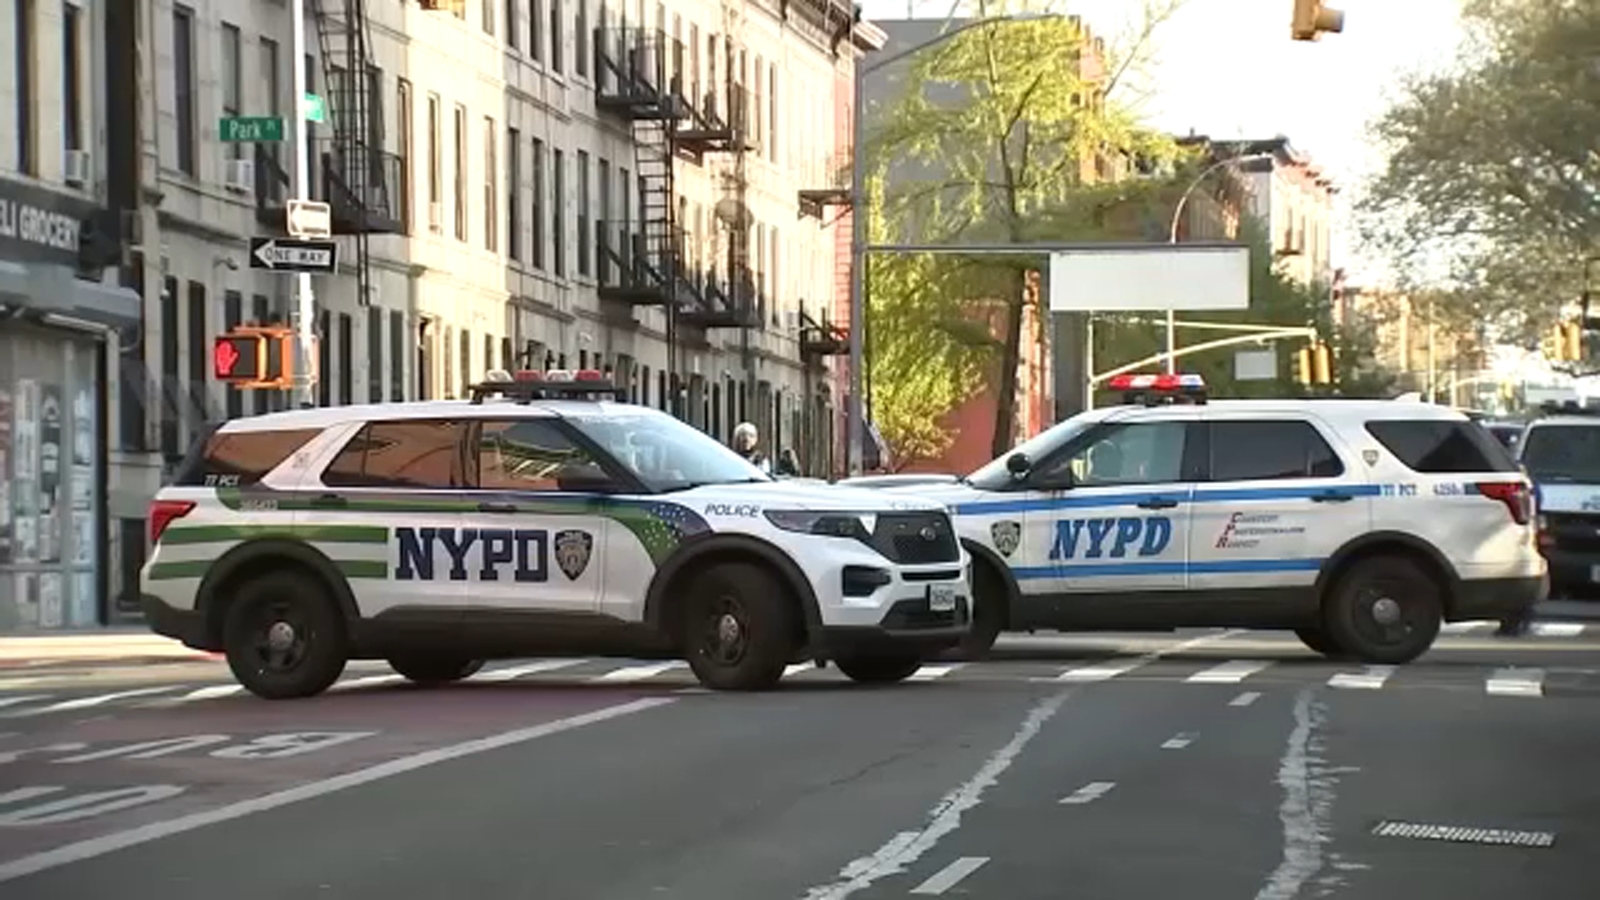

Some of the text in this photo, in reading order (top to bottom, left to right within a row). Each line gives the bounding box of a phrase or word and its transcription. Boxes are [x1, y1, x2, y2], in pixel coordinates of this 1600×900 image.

[229, 120, 261, 139] Park
[0, 199, 80, 253] LI GROCERY
[265, 247, 325, 263] ONE WAY
[705, 503, 760, 518] POLICE
[1049, 516, 1171, 560] NYPD
[395, 527, 548, 582] NYPD
